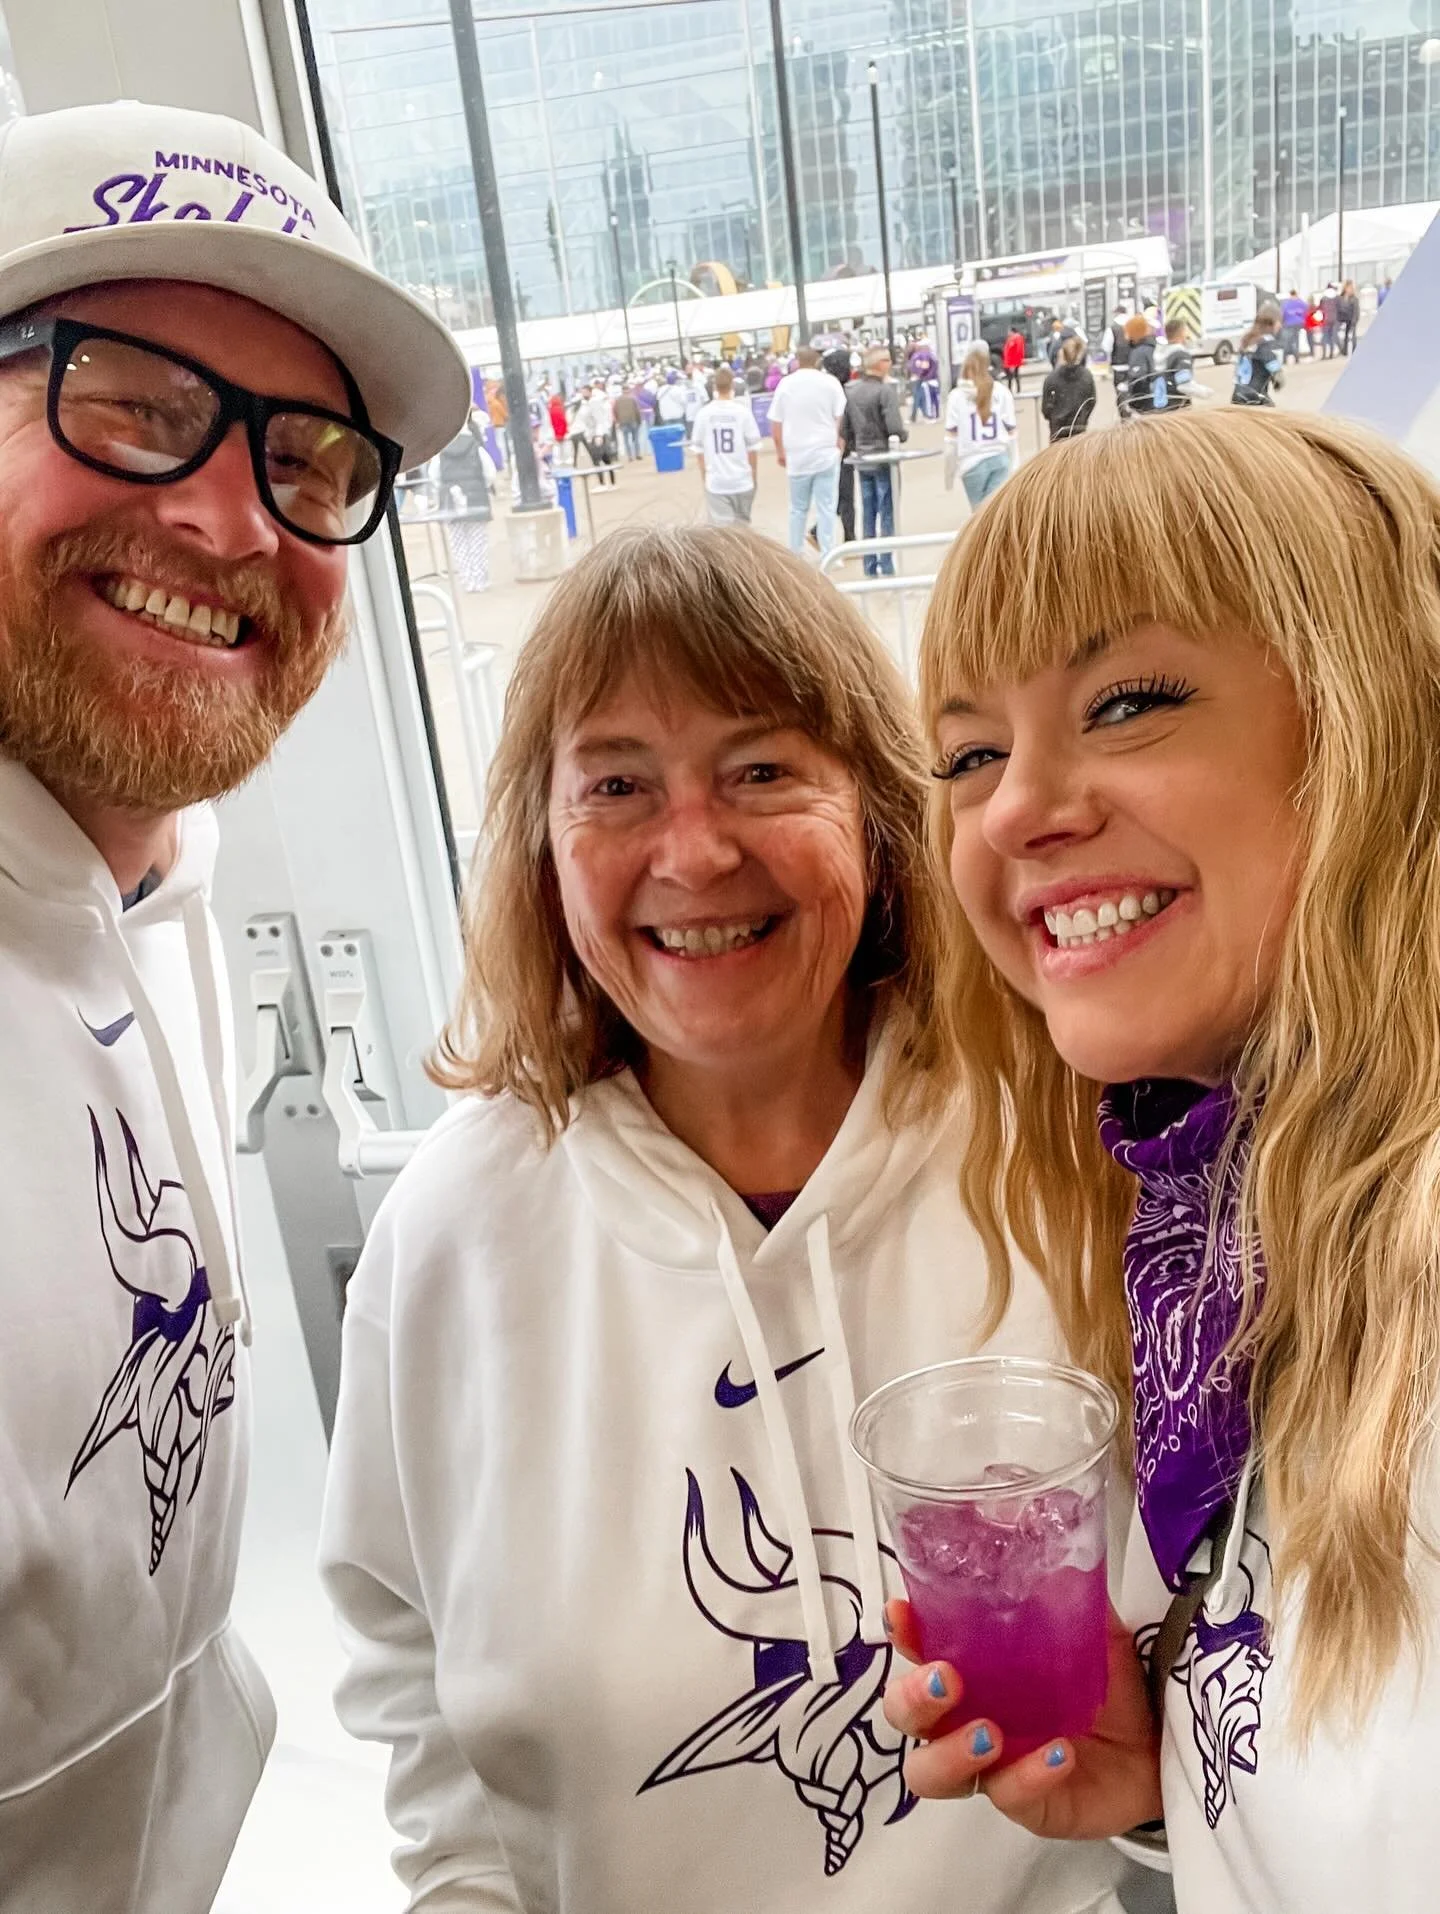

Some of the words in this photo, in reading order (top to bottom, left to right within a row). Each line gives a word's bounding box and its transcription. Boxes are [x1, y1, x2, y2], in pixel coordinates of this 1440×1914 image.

[155, 151, 316, 229] MINNESOTA
[970, 411, 997, 440] 19
[712, 428, 734, 454] 18
